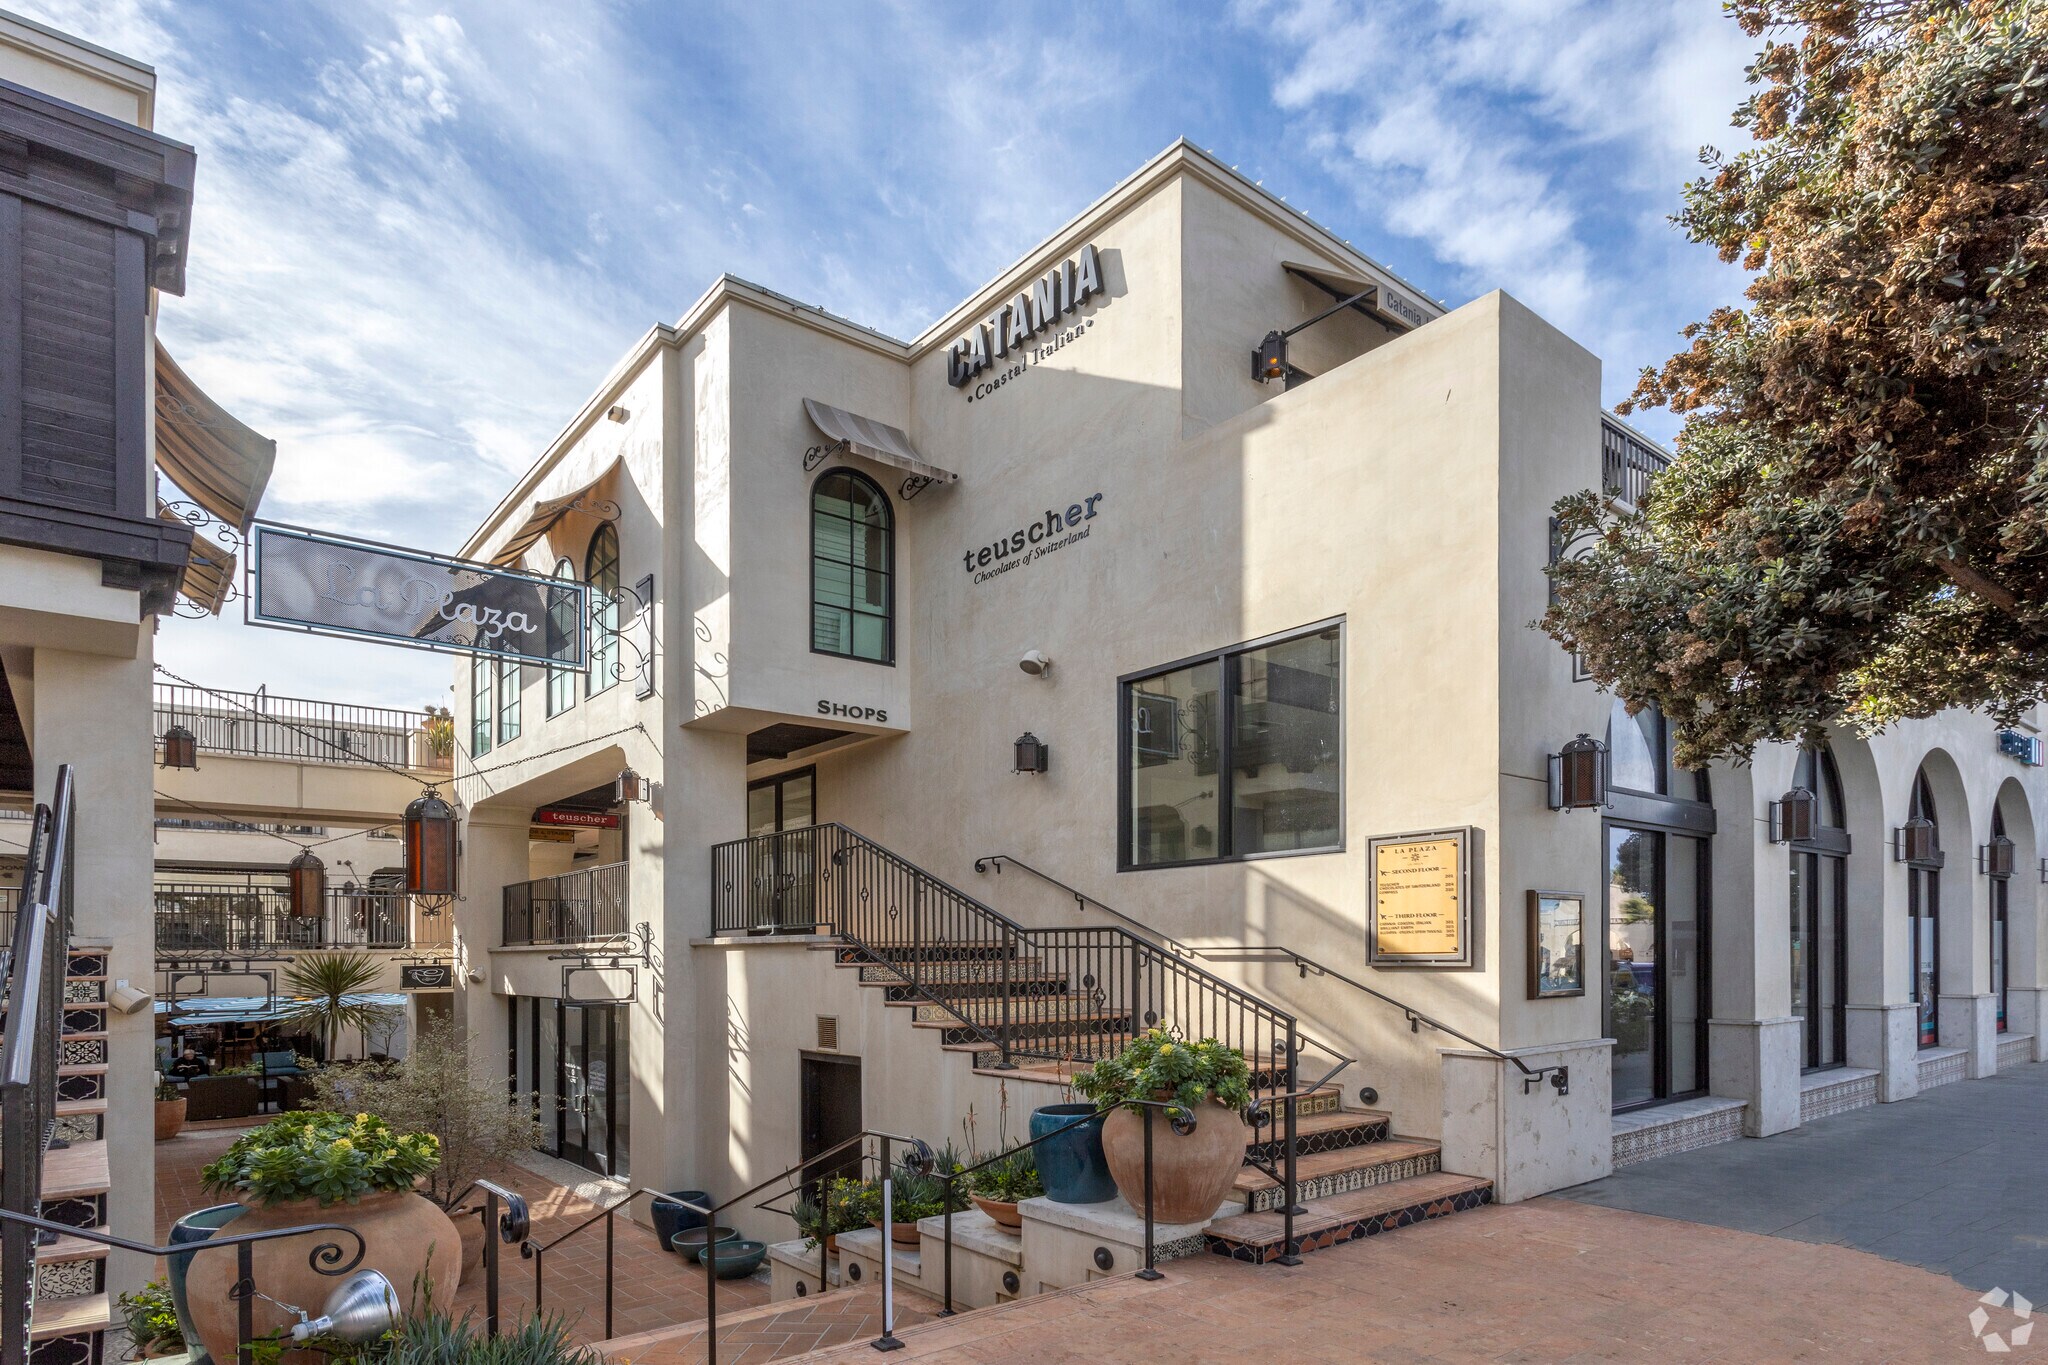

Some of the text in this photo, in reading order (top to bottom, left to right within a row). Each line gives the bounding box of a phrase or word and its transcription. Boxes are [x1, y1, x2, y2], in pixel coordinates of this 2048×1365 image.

[948, 244, 1104, 388] CATANIA
[1387, 292, 1422, 326] Catania
[975, 323, 1086, 400] Coastal Italian
[963, 493, 1103, 573] teuscher
[974, 525, 1091, 585] Chocolates of Switzerland
[321, 559, 538, 638] La Plaza
[817, 700, 888, 722] SHOPS
[552, 812, 608, 824] teuscher
[1408, 845, 1437, 853] PLAZA
